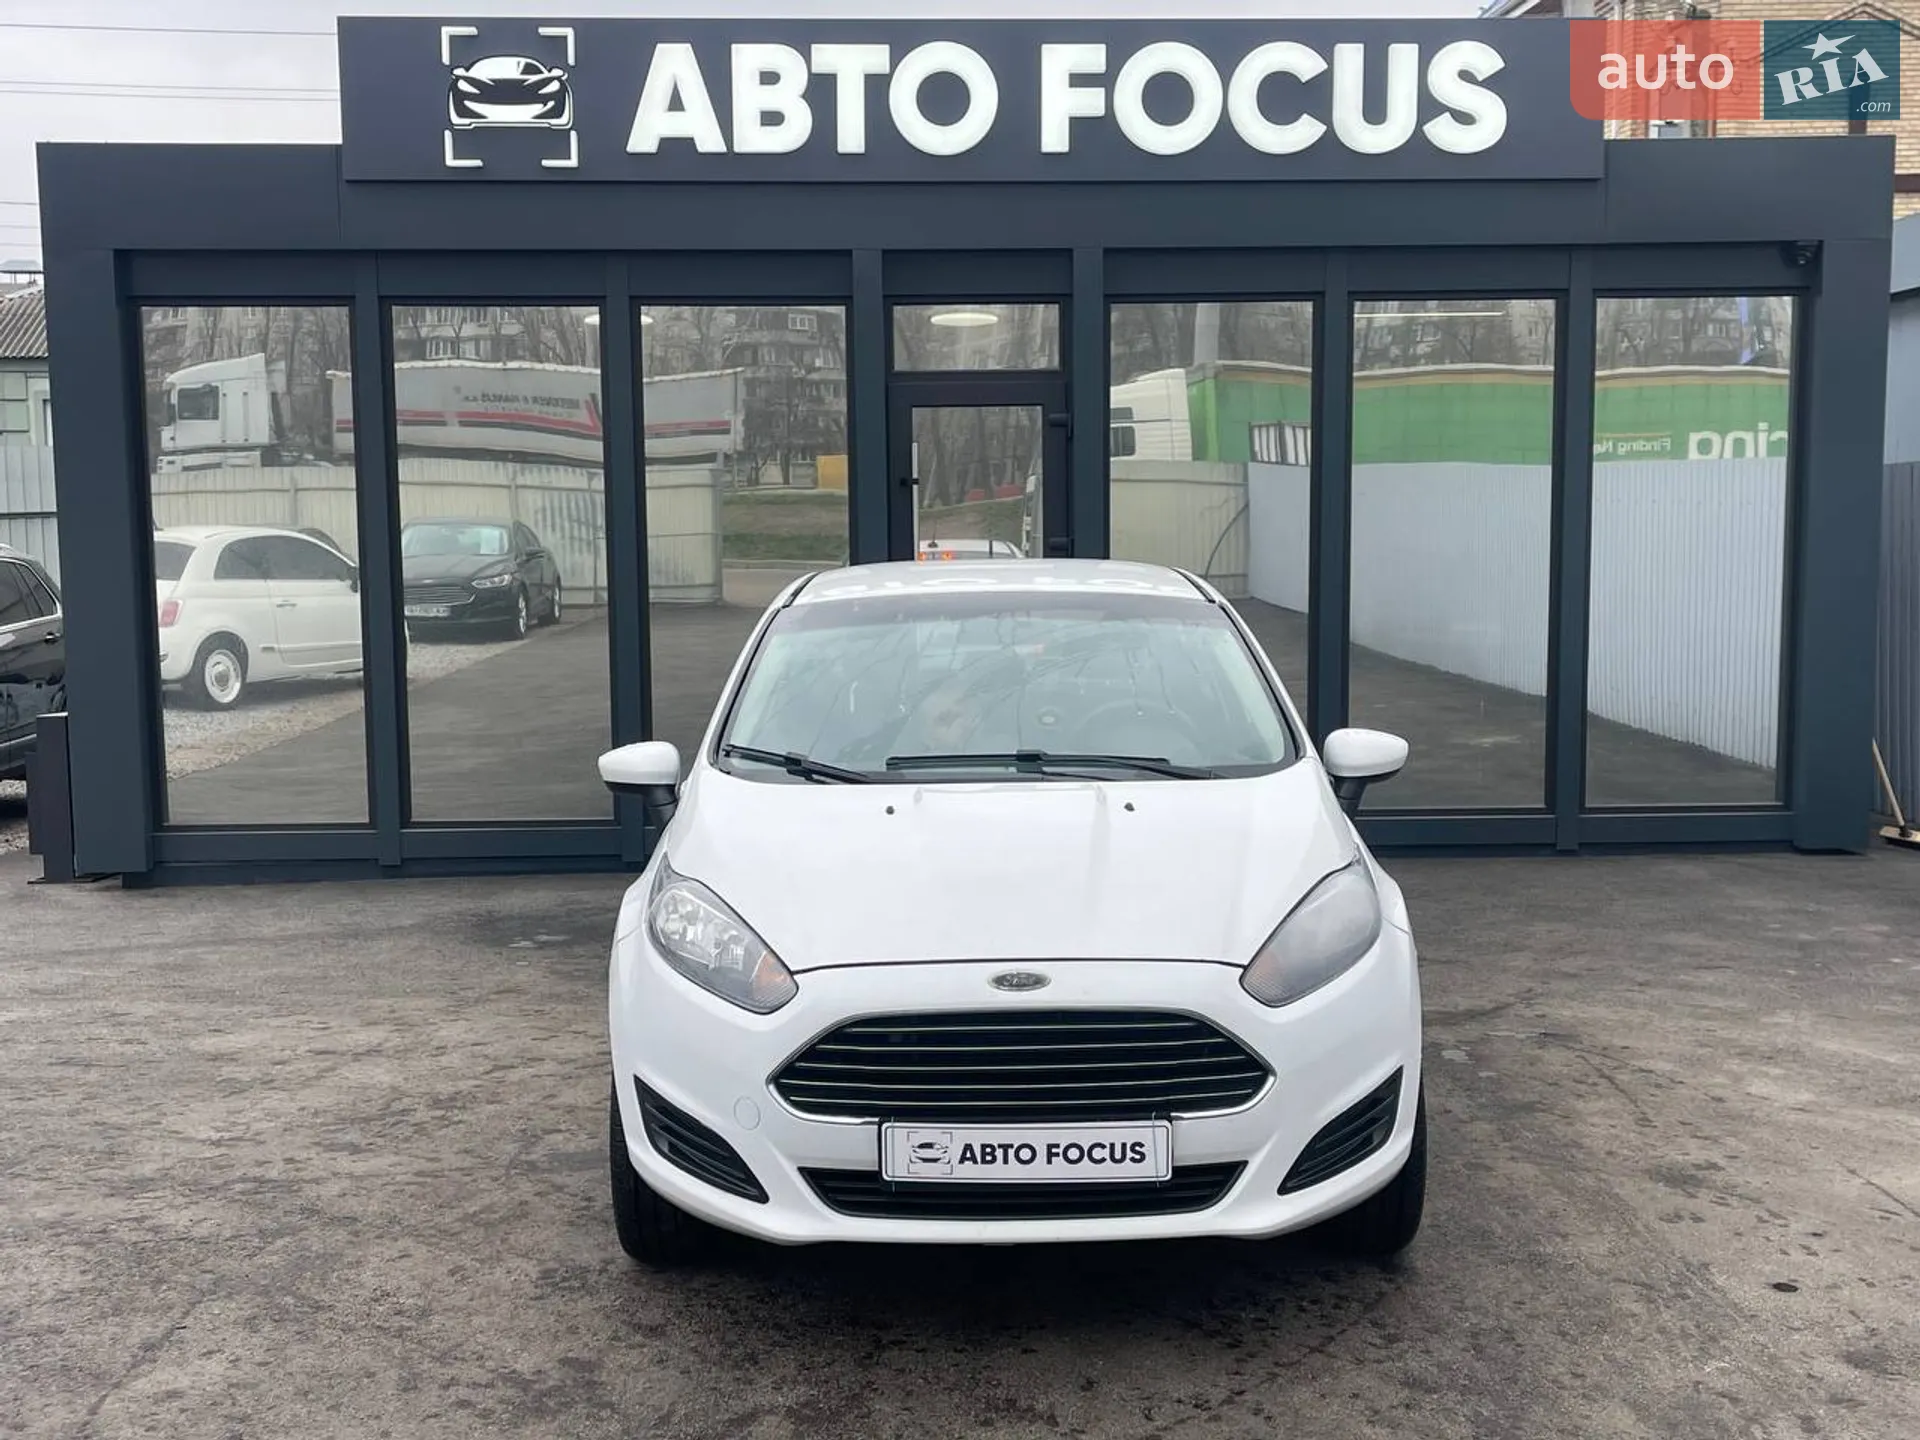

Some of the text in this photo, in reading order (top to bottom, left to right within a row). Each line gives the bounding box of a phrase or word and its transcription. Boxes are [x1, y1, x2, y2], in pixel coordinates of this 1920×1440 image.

[626, 41, 1507, 156] АВТО FOCUS
[958, 1141, 1146, 1166] АВТО FOCUS
